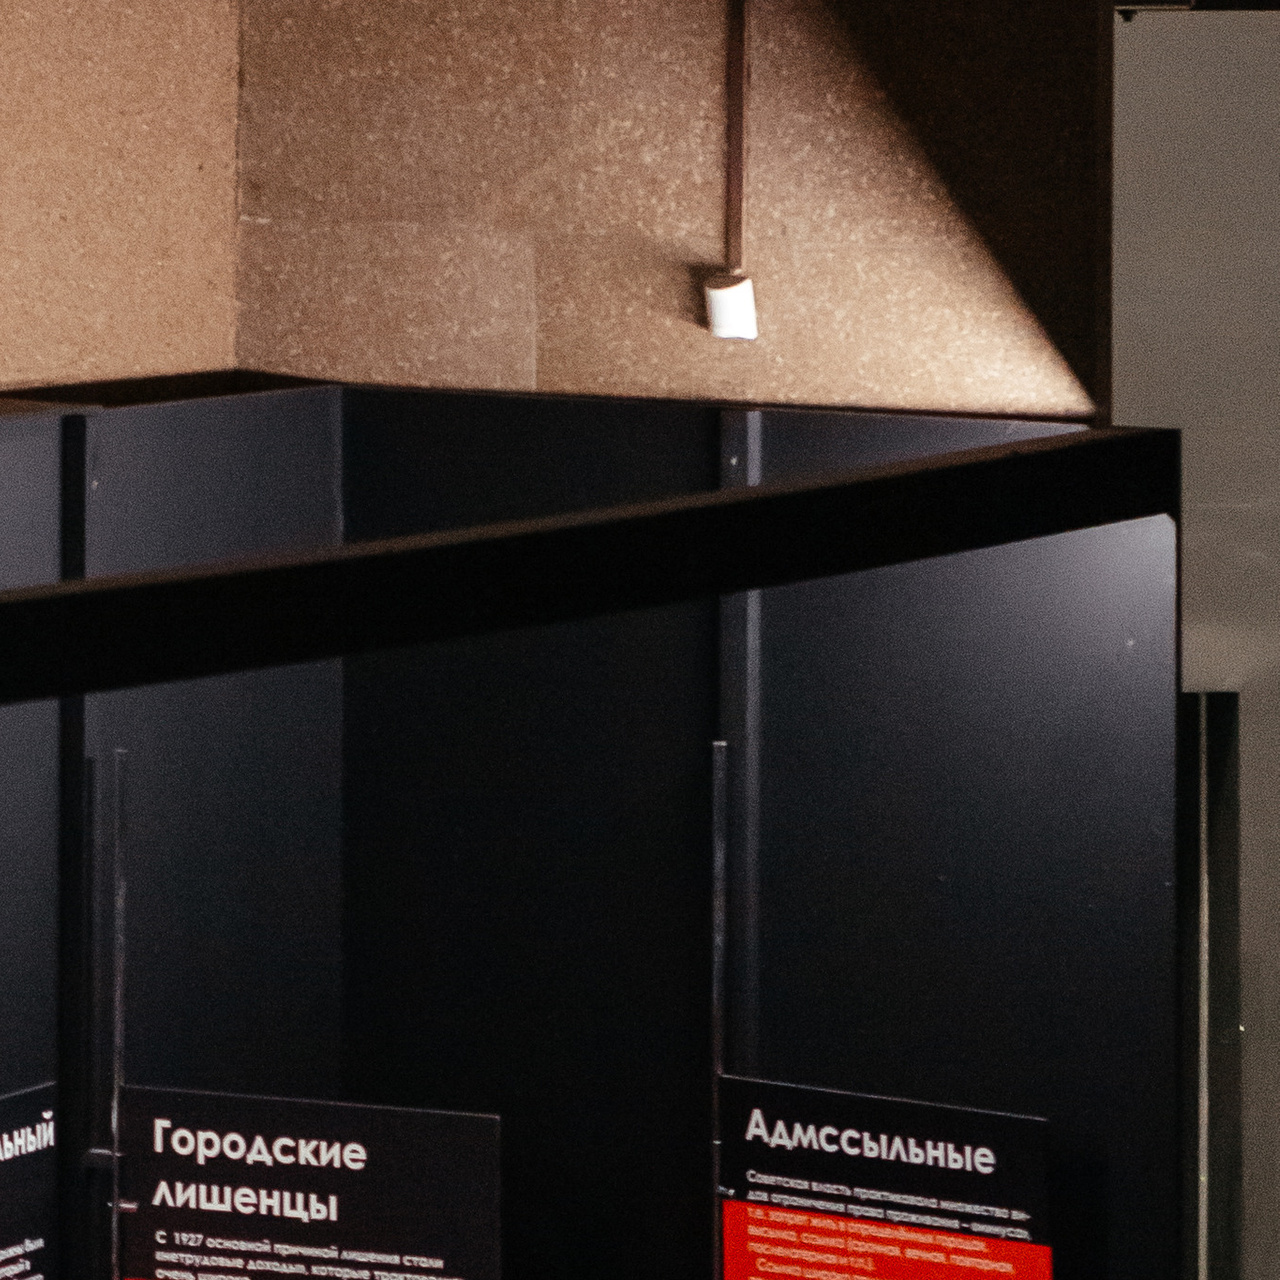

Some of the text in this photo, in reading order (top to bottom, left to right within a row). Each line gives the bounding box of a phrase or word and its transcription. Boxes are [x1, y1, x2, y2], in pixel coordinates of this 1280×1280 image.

[153, 1118, 367, 1170] Городские
[746, 1109, 996, 1174] Адмссыльные
[152, 1180, 338, 1223] лишенцы
